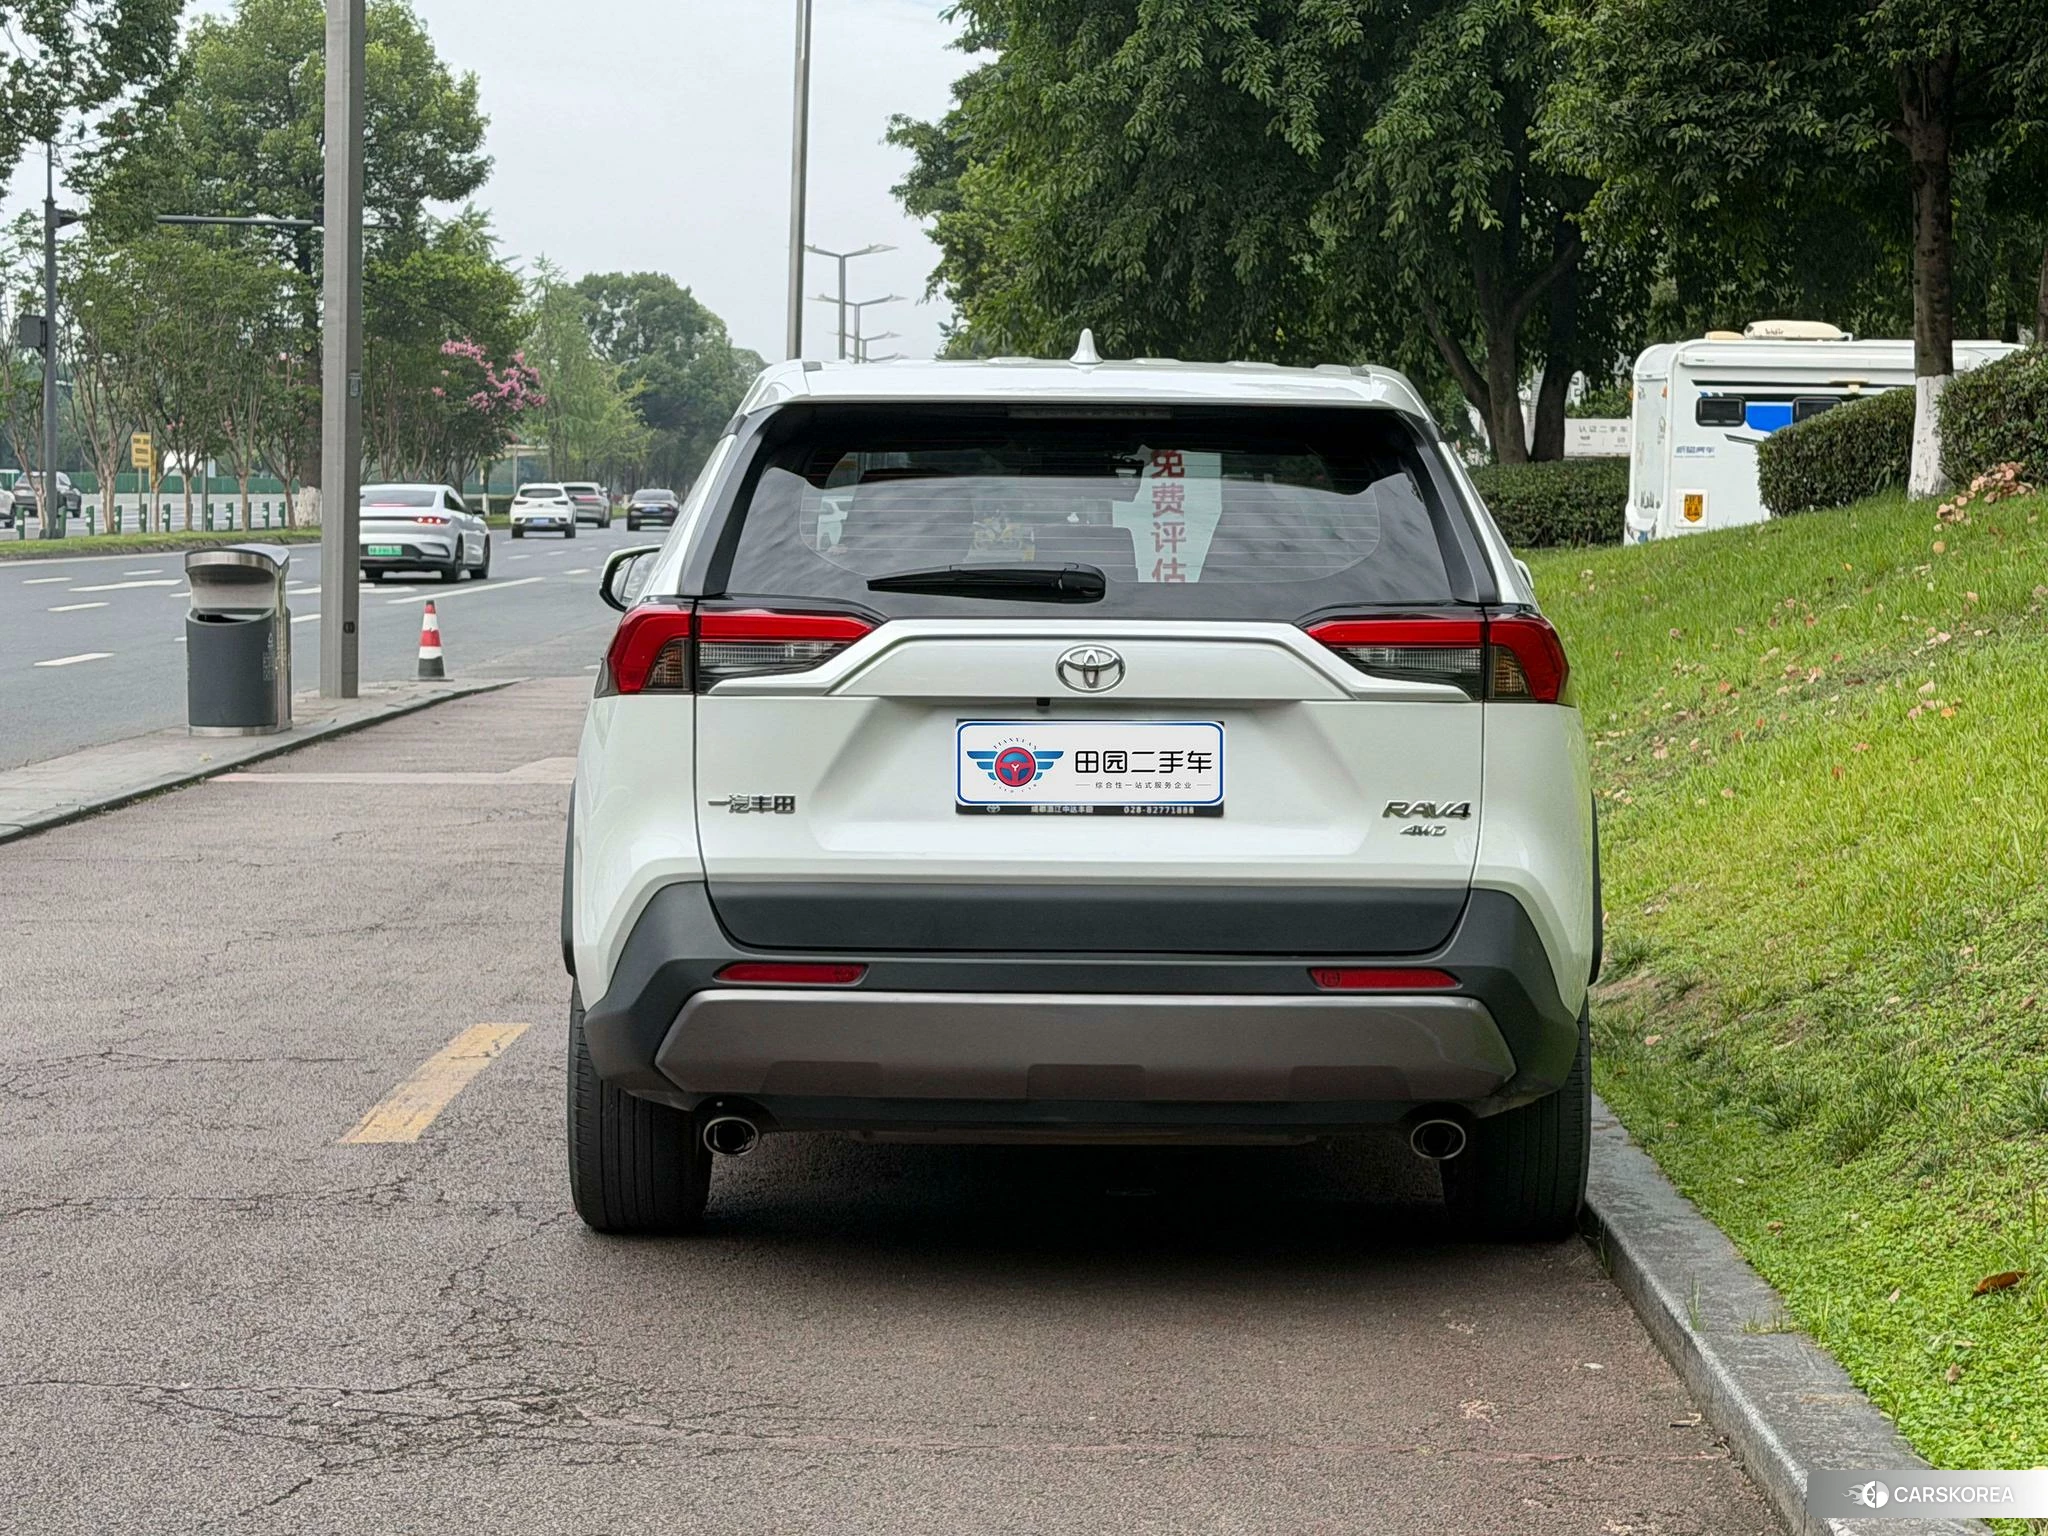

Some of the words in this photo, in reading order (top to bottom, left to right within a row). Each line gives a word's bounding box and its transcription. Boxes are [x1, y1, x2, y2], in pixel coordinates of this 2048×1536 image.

[1152, 450, 1186, 583] 免费评估
[708, 794, 795, 814] 一汽丰田
[1382, 800, 1471, 819] RAV4
[1400, 824, 1447, 837] 4WD
